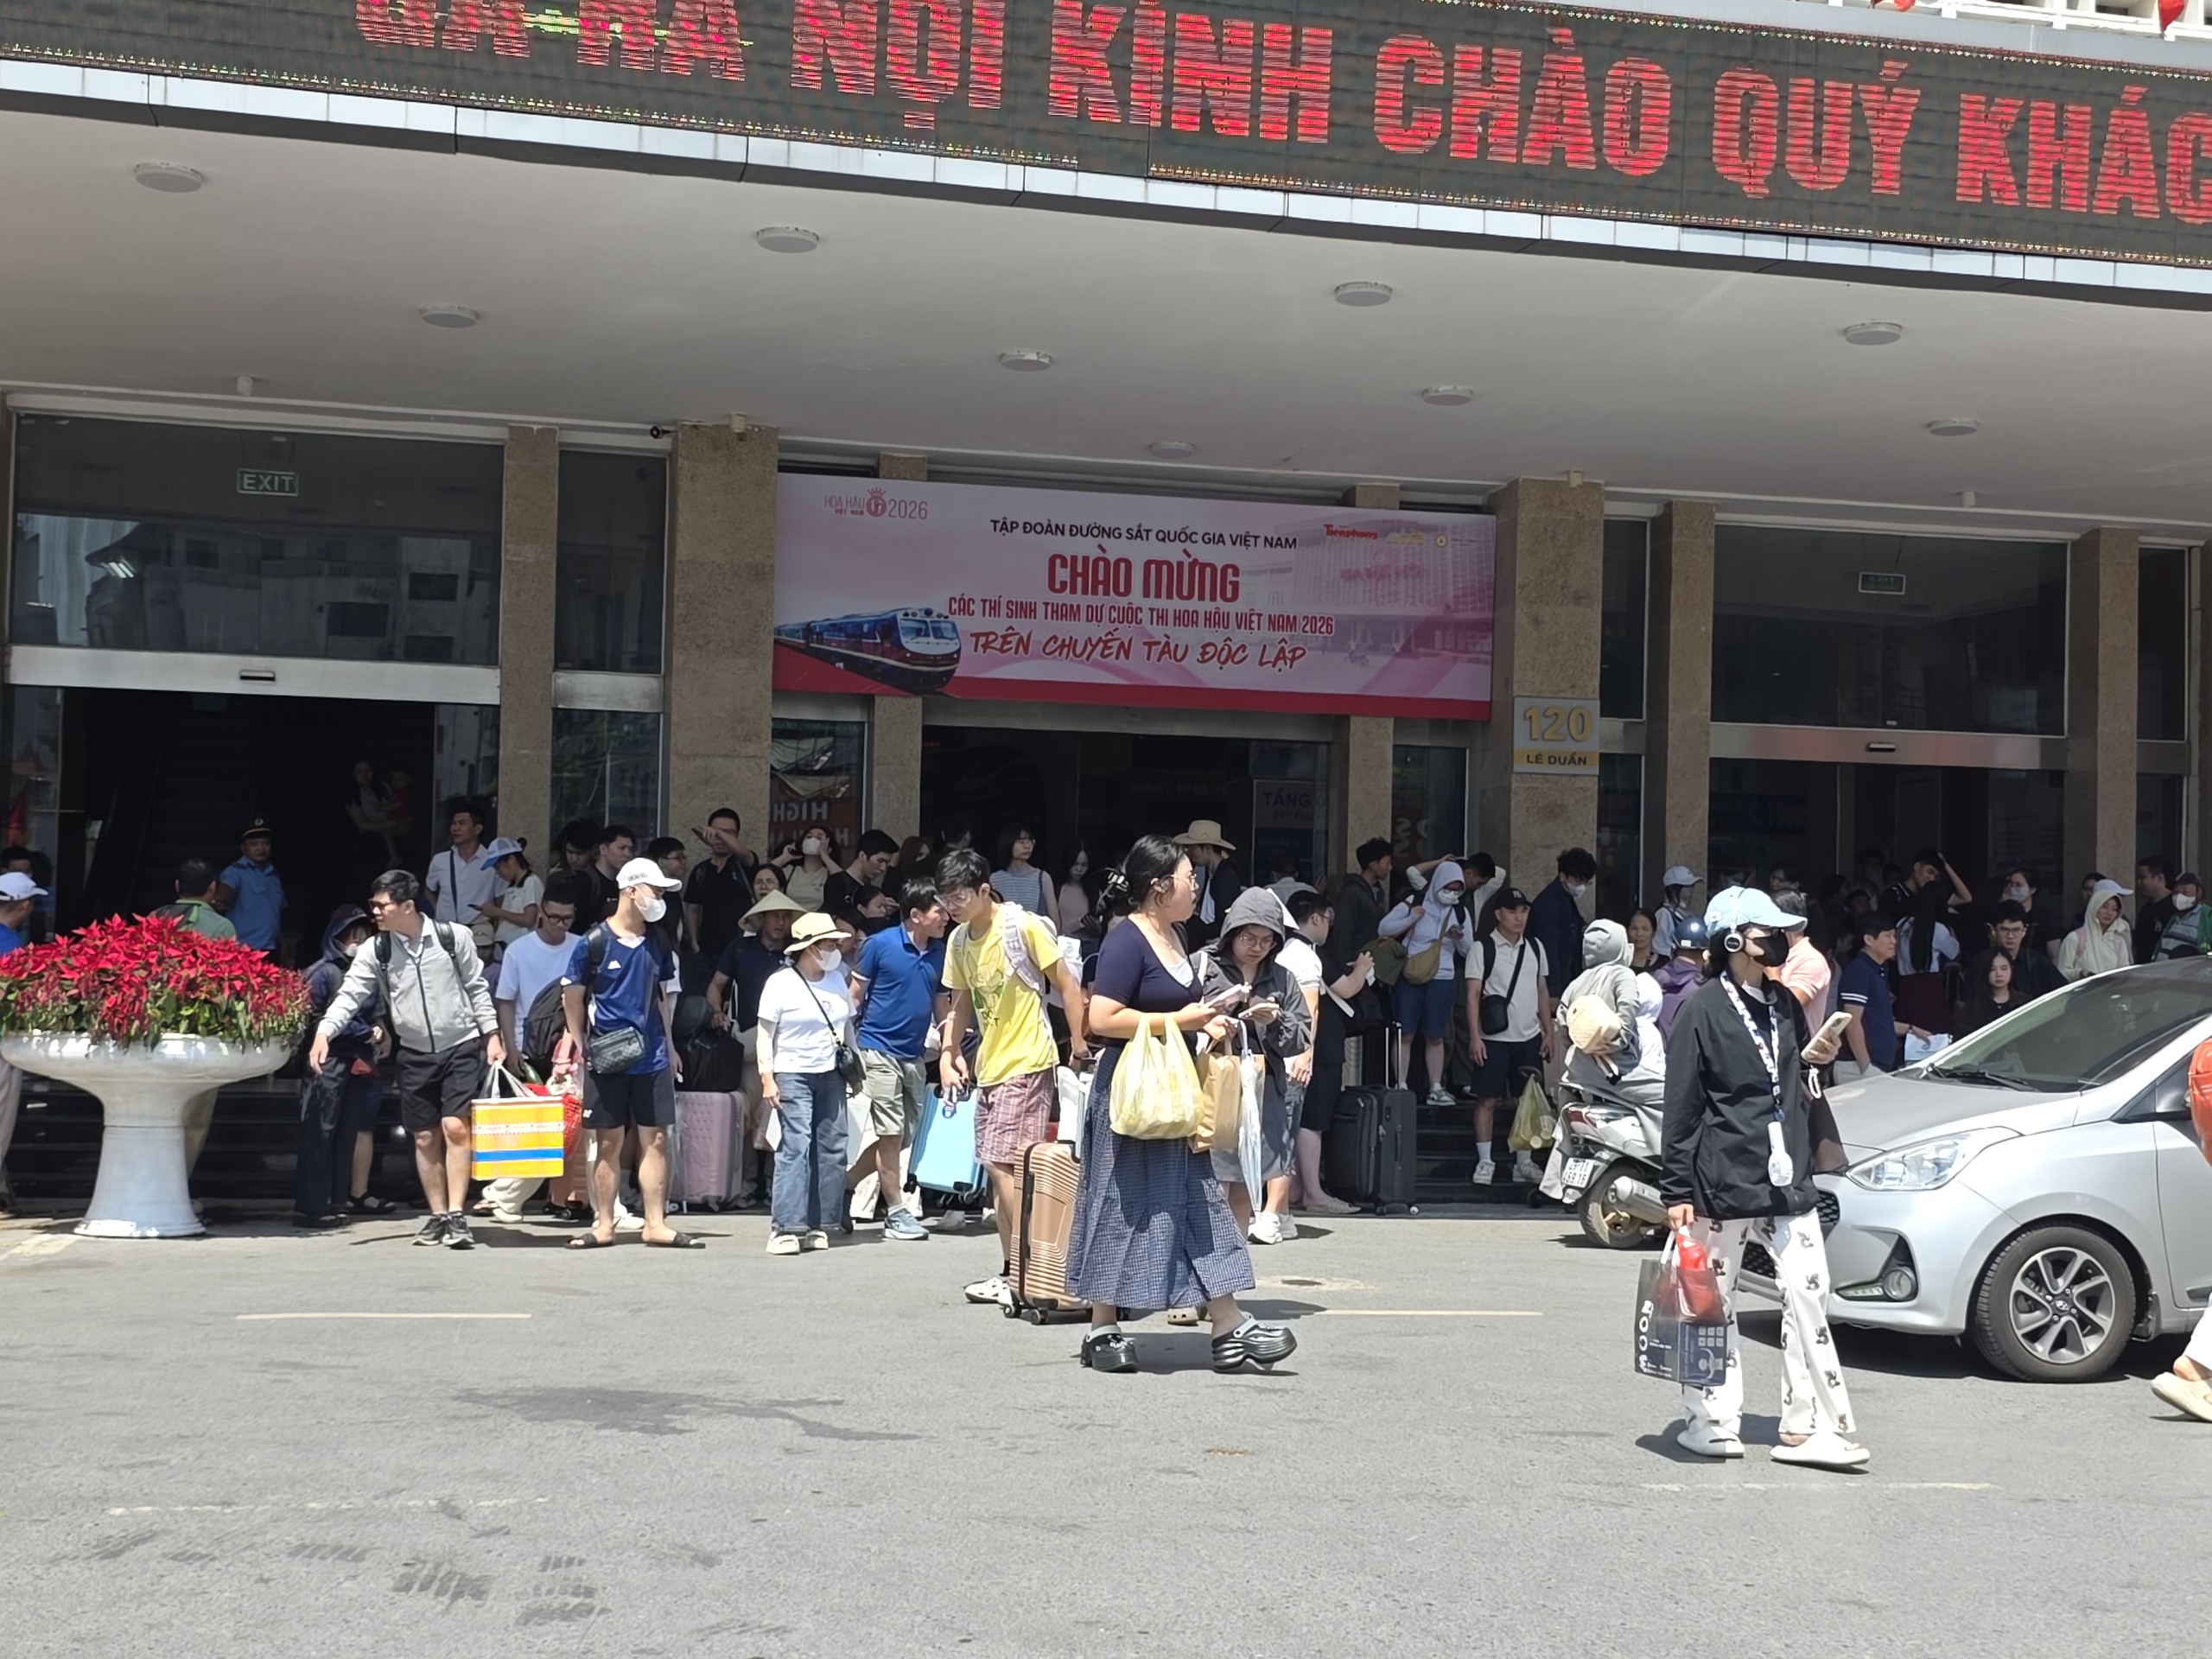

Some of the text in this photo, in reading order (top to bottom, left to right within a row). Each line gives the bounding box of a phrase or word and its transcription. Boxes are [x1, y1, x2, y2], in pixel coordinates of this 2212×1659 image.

[1373, 27, 1673, 176] CHÀO
[1712, 60, 1921, 200] QUÝ
[243, 474, 295, 492] EXIT
[888, 499, 928, 520] 2026
[990, 517, 1297, 550] TẬP ĐOÀN ĐƯỜNG SẮT QUỐC GIA VIỆT NAM
[1047, 544, 1132, 598] CHÀO
[949, 594, 1333, 635] CÁC THÍ SINH THAM DỰ CUỘC THI HOA HẬU VIỆT NAM 2026
[969, 626, 1307, 672] TRÊN CHUYẾN TÀU ĐỘC LẬP
[1523, 705, 1592, 742] 120
[1526, 753, 1544, 764] LÊ
